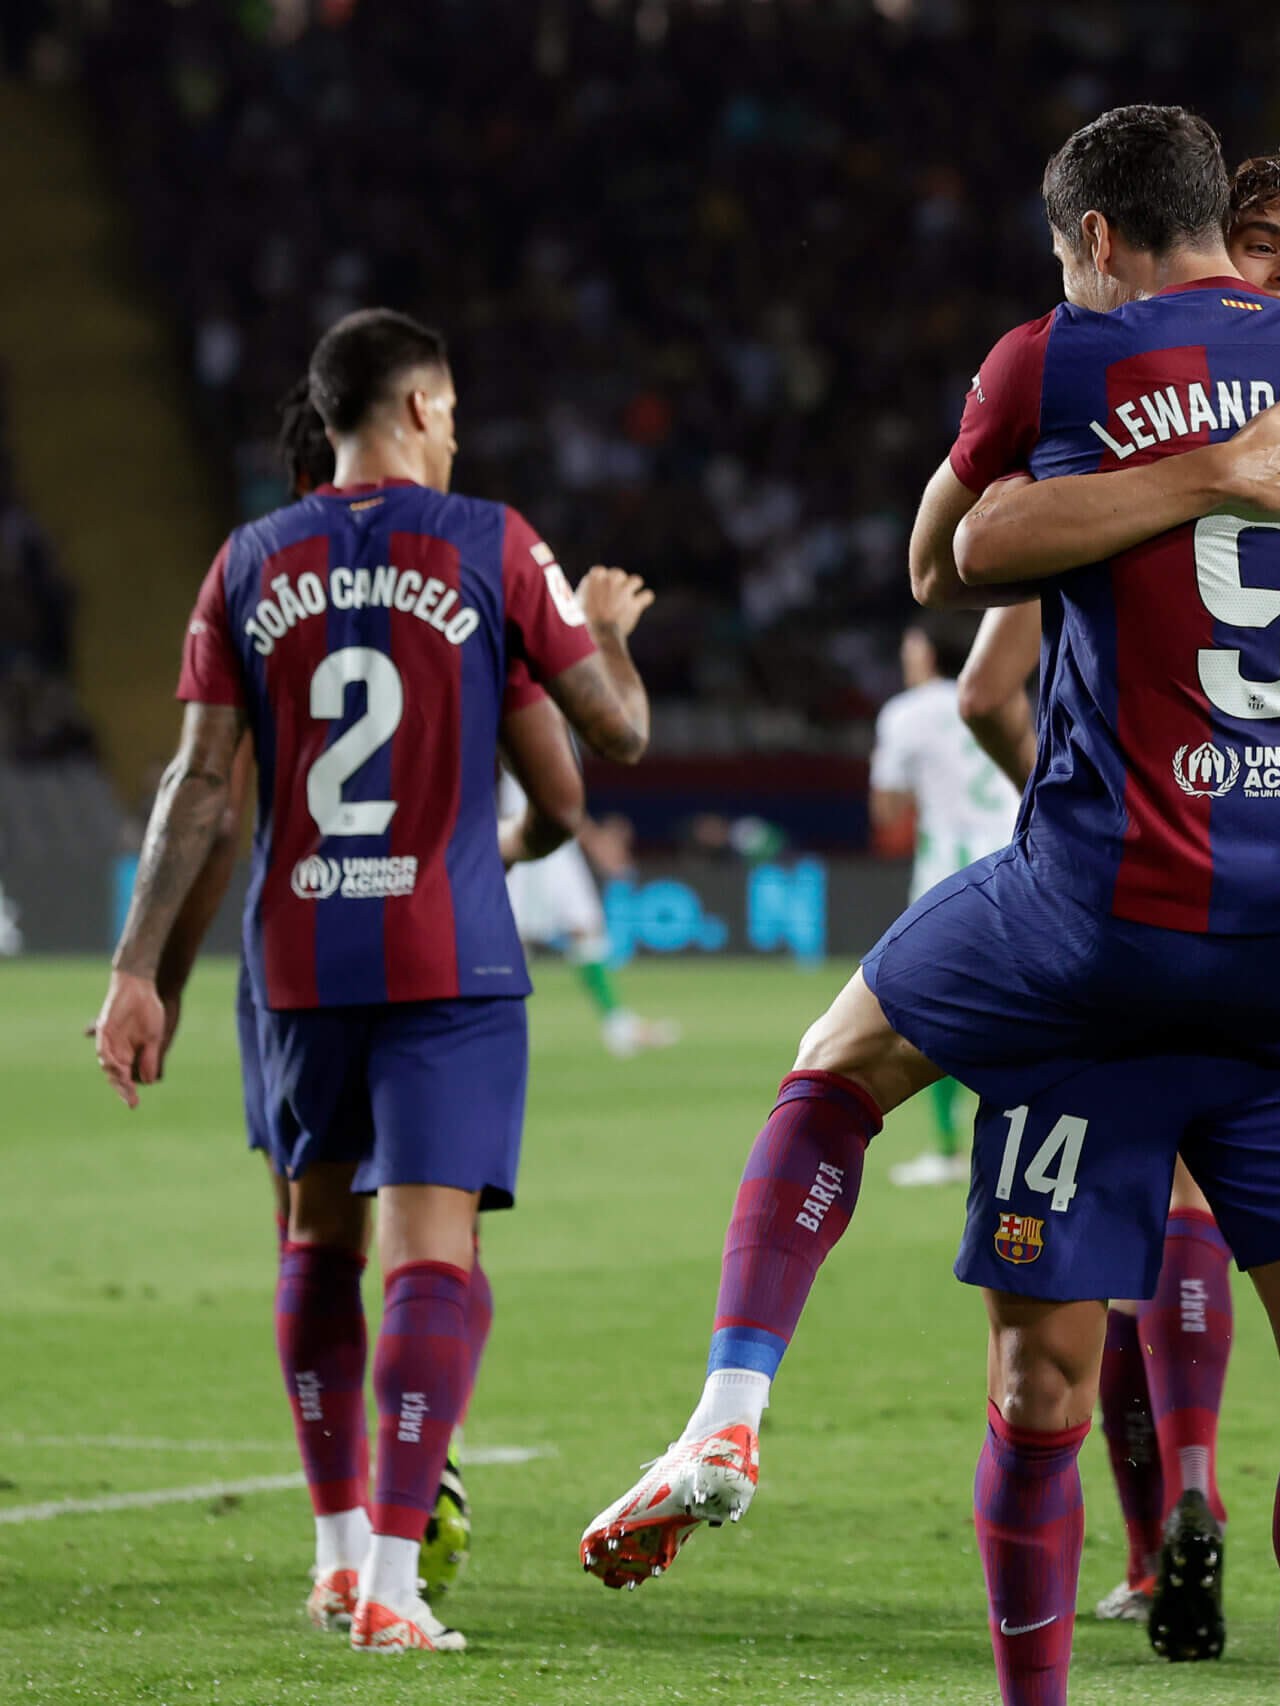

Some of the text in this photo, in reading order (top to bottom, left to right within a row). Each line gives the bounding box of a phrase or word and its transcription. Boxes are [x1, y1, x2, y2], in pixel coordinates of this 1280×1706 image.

[245, 565, 480, 656] JOÃO CANCELO
[306, 646, 404, 835] 2
[1244, 789, 1259, 797] The
[1260, 789, 1273, 797] UN
[995, 1105, 1088, 1212] 14
[795, 1162, 844, 1233] BARÇA
[1180, 1279, 1208, 1332] BARÇA
[397, 1392, 429, 1443] BARÇA
